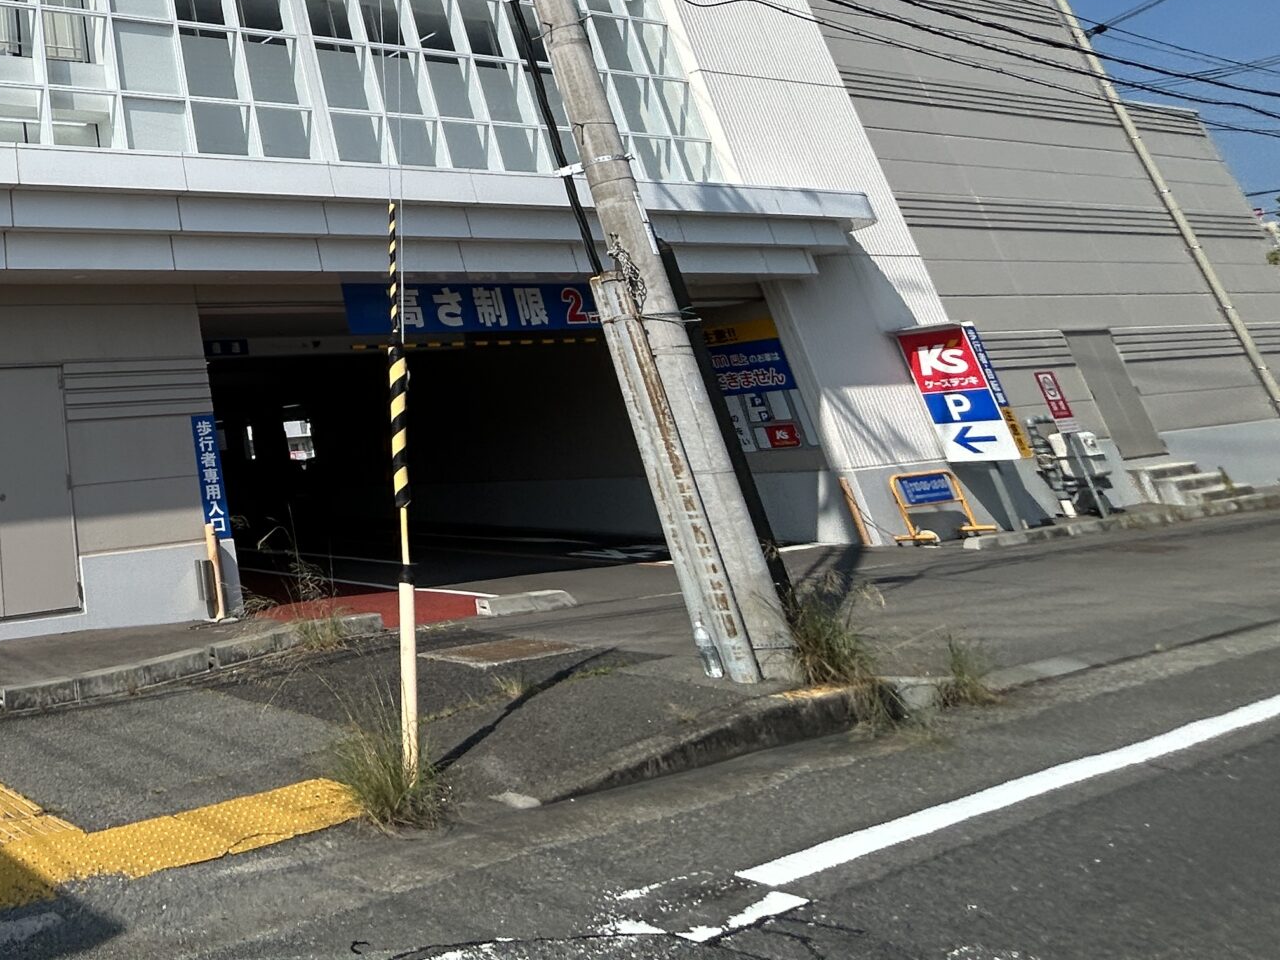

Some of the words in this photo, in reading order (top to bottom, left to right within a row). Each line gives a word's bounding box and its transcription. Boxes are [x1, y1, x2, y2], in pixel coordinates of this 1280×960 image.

[387, 287, 549, 328] 高さ制限
[917, 339, 969, 376] K's
[924, 376, 980, 388] ケーズデンキ
[944, 393, 971, 421] P
[196, 420, 226, 532] 歩行者専用入口
